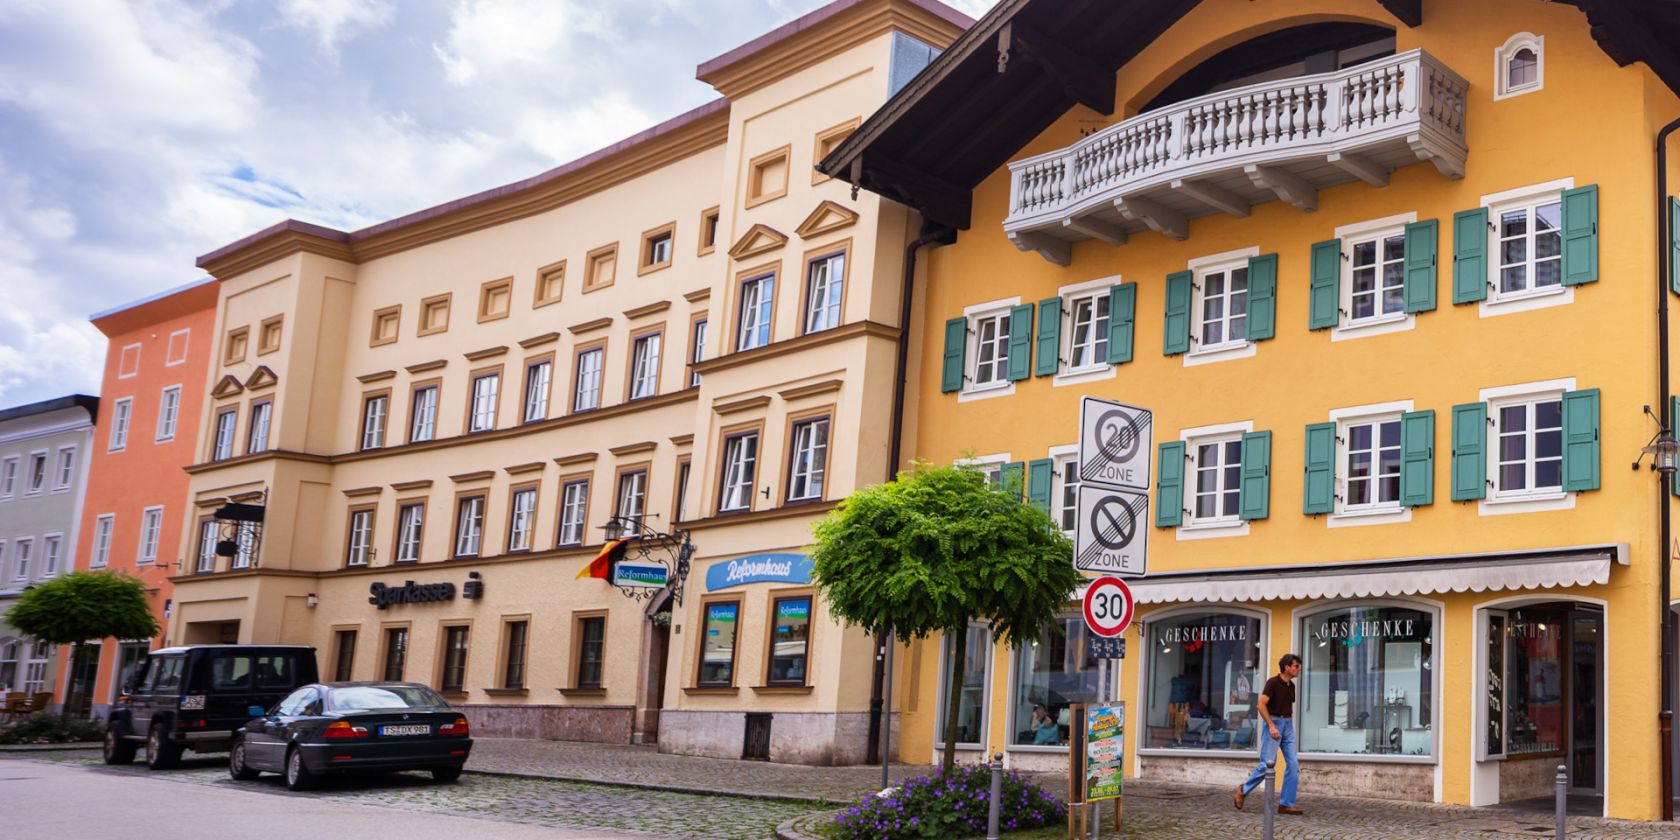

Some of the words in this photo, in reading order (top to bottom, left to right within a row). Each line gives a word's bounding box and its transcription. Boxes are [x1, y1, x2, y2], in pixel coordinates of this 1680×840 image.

[1106, 423, 1131, 450] 20
[1098, 465, 1133, 482] ZONE
[1094, 552, 1129, 568] ZONE
[618, 568, 667, 580] Reformhaus
[726, 558, 792, 582] Reformhaus
[369, 581, 455, 609] Sparkasse
[1095, 593, 1123, 620] 30
[1165, 625, 1246, 642] GESCHENKE
[1321, 619, 1414, 638] GESCHENKE
